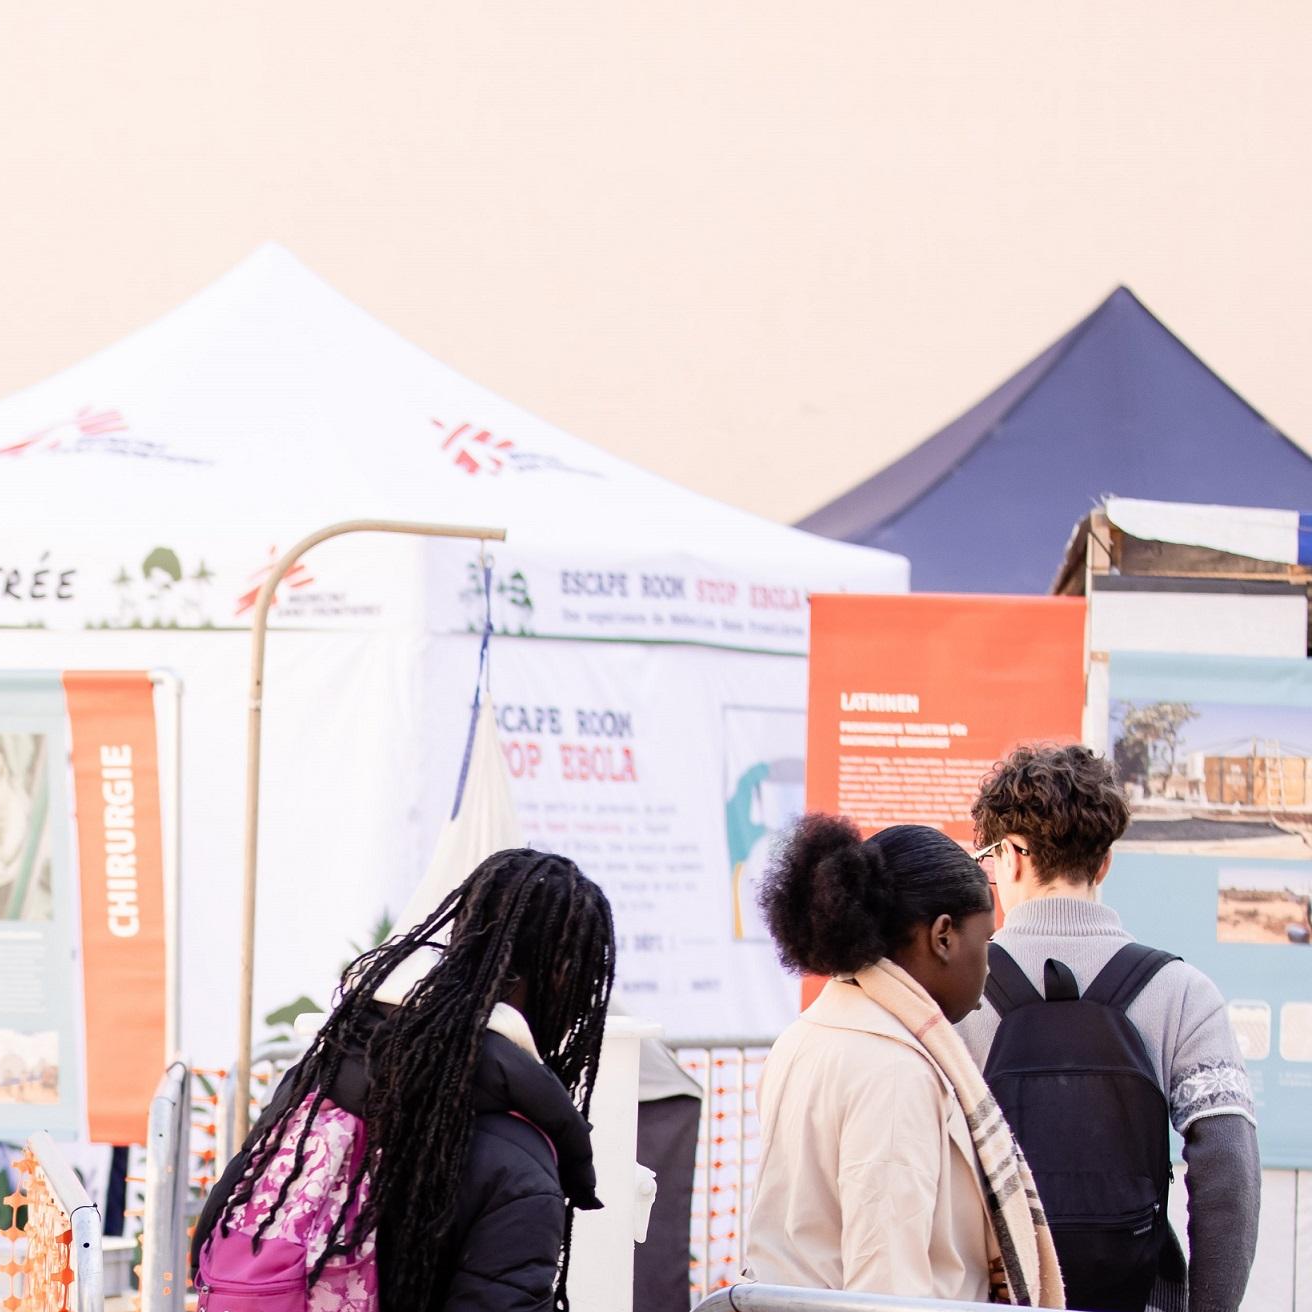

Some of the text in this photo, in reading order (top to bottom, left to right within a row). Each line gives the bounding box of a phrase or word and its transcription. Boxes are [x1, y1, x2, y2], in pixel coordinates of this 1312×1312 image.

[494, 703, 635, 738] CAPE ROOM
[840, 691, 920, 713] LATRINEN
[560, 743, 639, 783] EBOLA
[100, 744, 140, 938] CHIRURGIE
